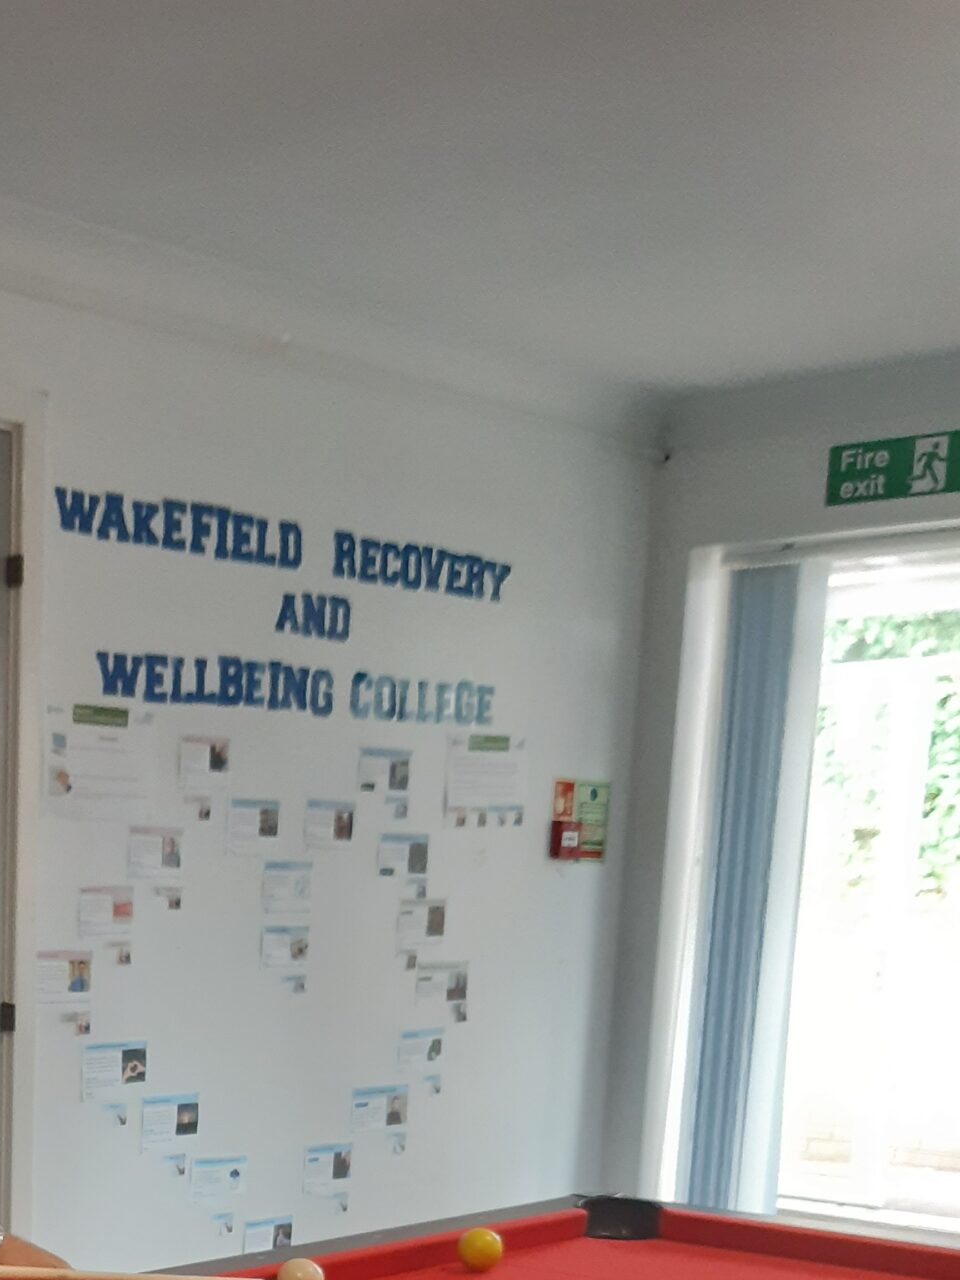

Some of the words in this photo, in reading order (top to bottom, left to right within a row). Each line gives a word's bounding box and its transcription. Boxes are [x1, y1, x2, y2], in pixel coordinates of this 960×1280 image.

[841, 449, 890, 471] Fire
[840, 474, 886, 499] exit
[54, 486, 303, 570] WAKEFIELD
[332, 529, 512, 602] RECOVERY
[274, 592, 352, 643] AND
[95, 650, 335, 718] WELLBEING
[349, 670, 496, 726] COLLEGE
